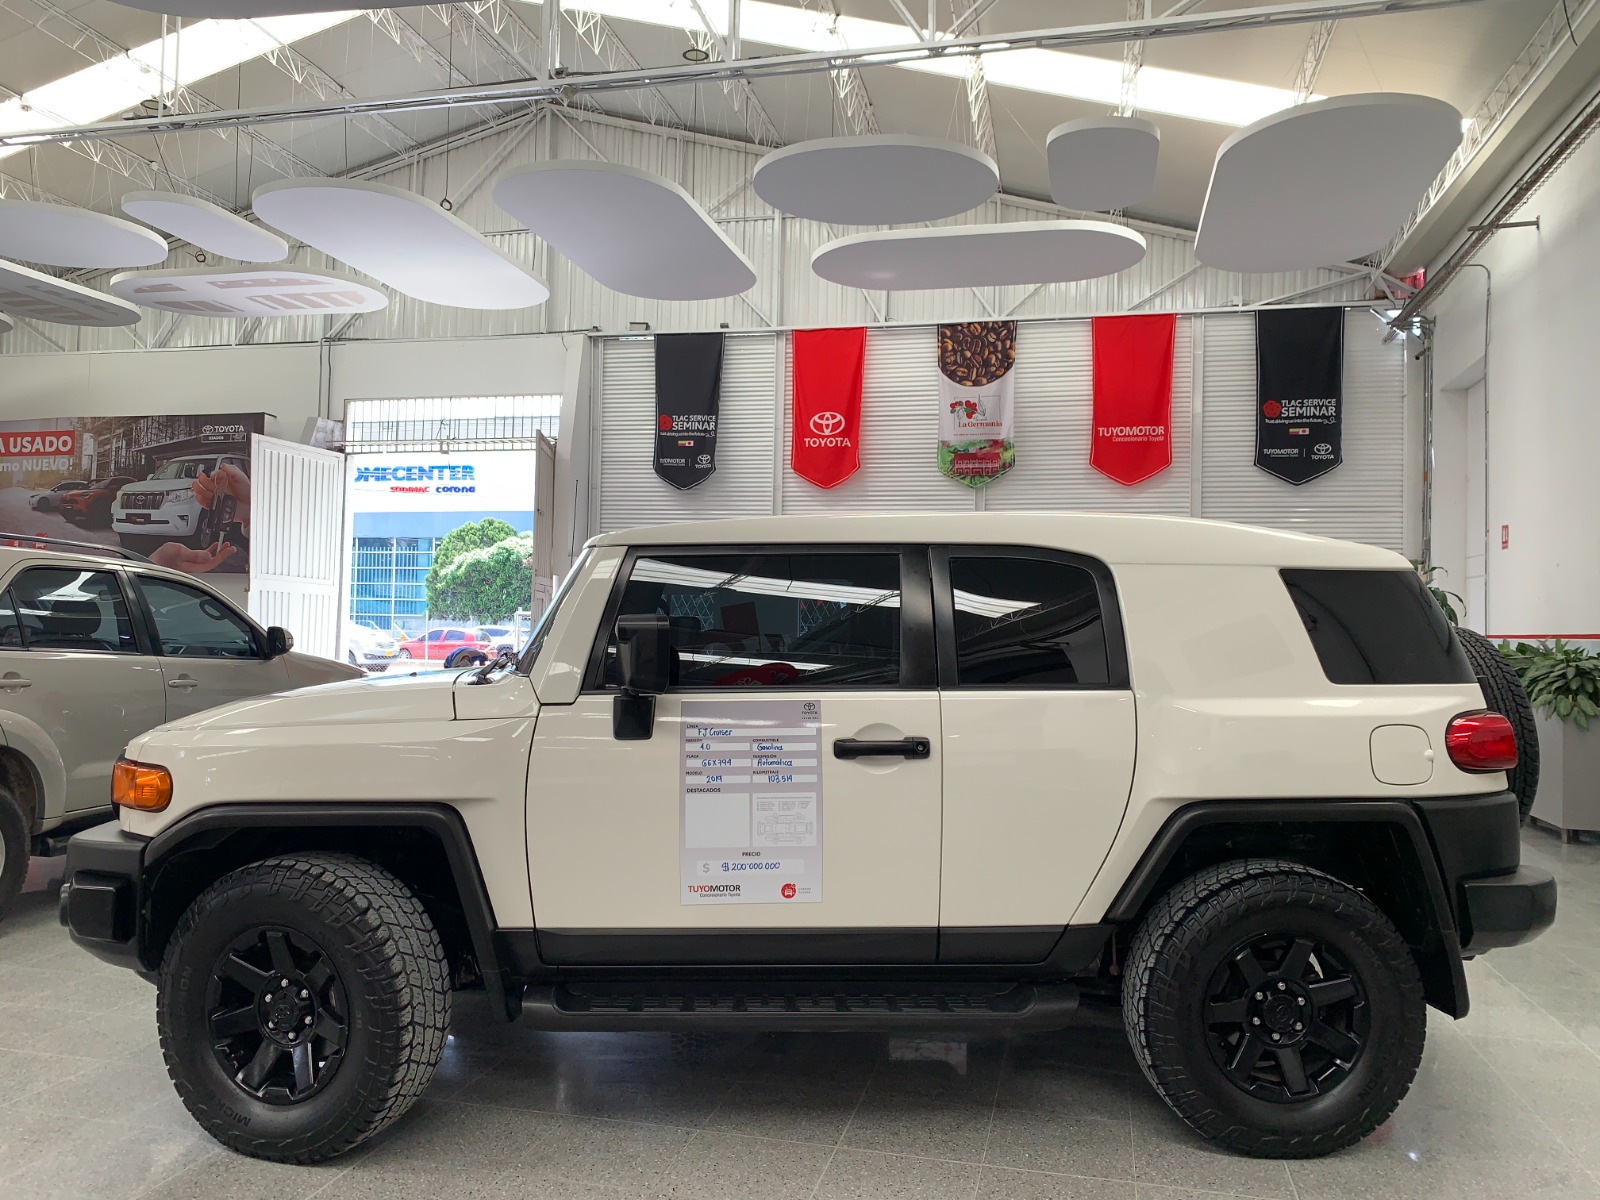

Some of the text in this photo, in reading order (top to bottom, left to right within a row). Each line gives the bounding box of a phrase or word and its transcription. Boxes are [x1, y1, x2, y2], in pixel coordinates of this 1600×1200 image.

[1281, 399, 1302, 407] TLAC
[1281, 406, 1336, 417] SEMINAR
[214, 425, 244, 433] TOYOTA
[672, 421, 715, 430] SEMINAR
[1098, 426, 1165, 436] TUYOMOTOR
[9, 436, 73, 453] USADO
[804, 437, 851, 448] TOYOTA
[22, 457, 73, 471] NUEVO!
[435, 485, 476, 493] corona
[687, 884, 741, 893] TUYOMOTOR
